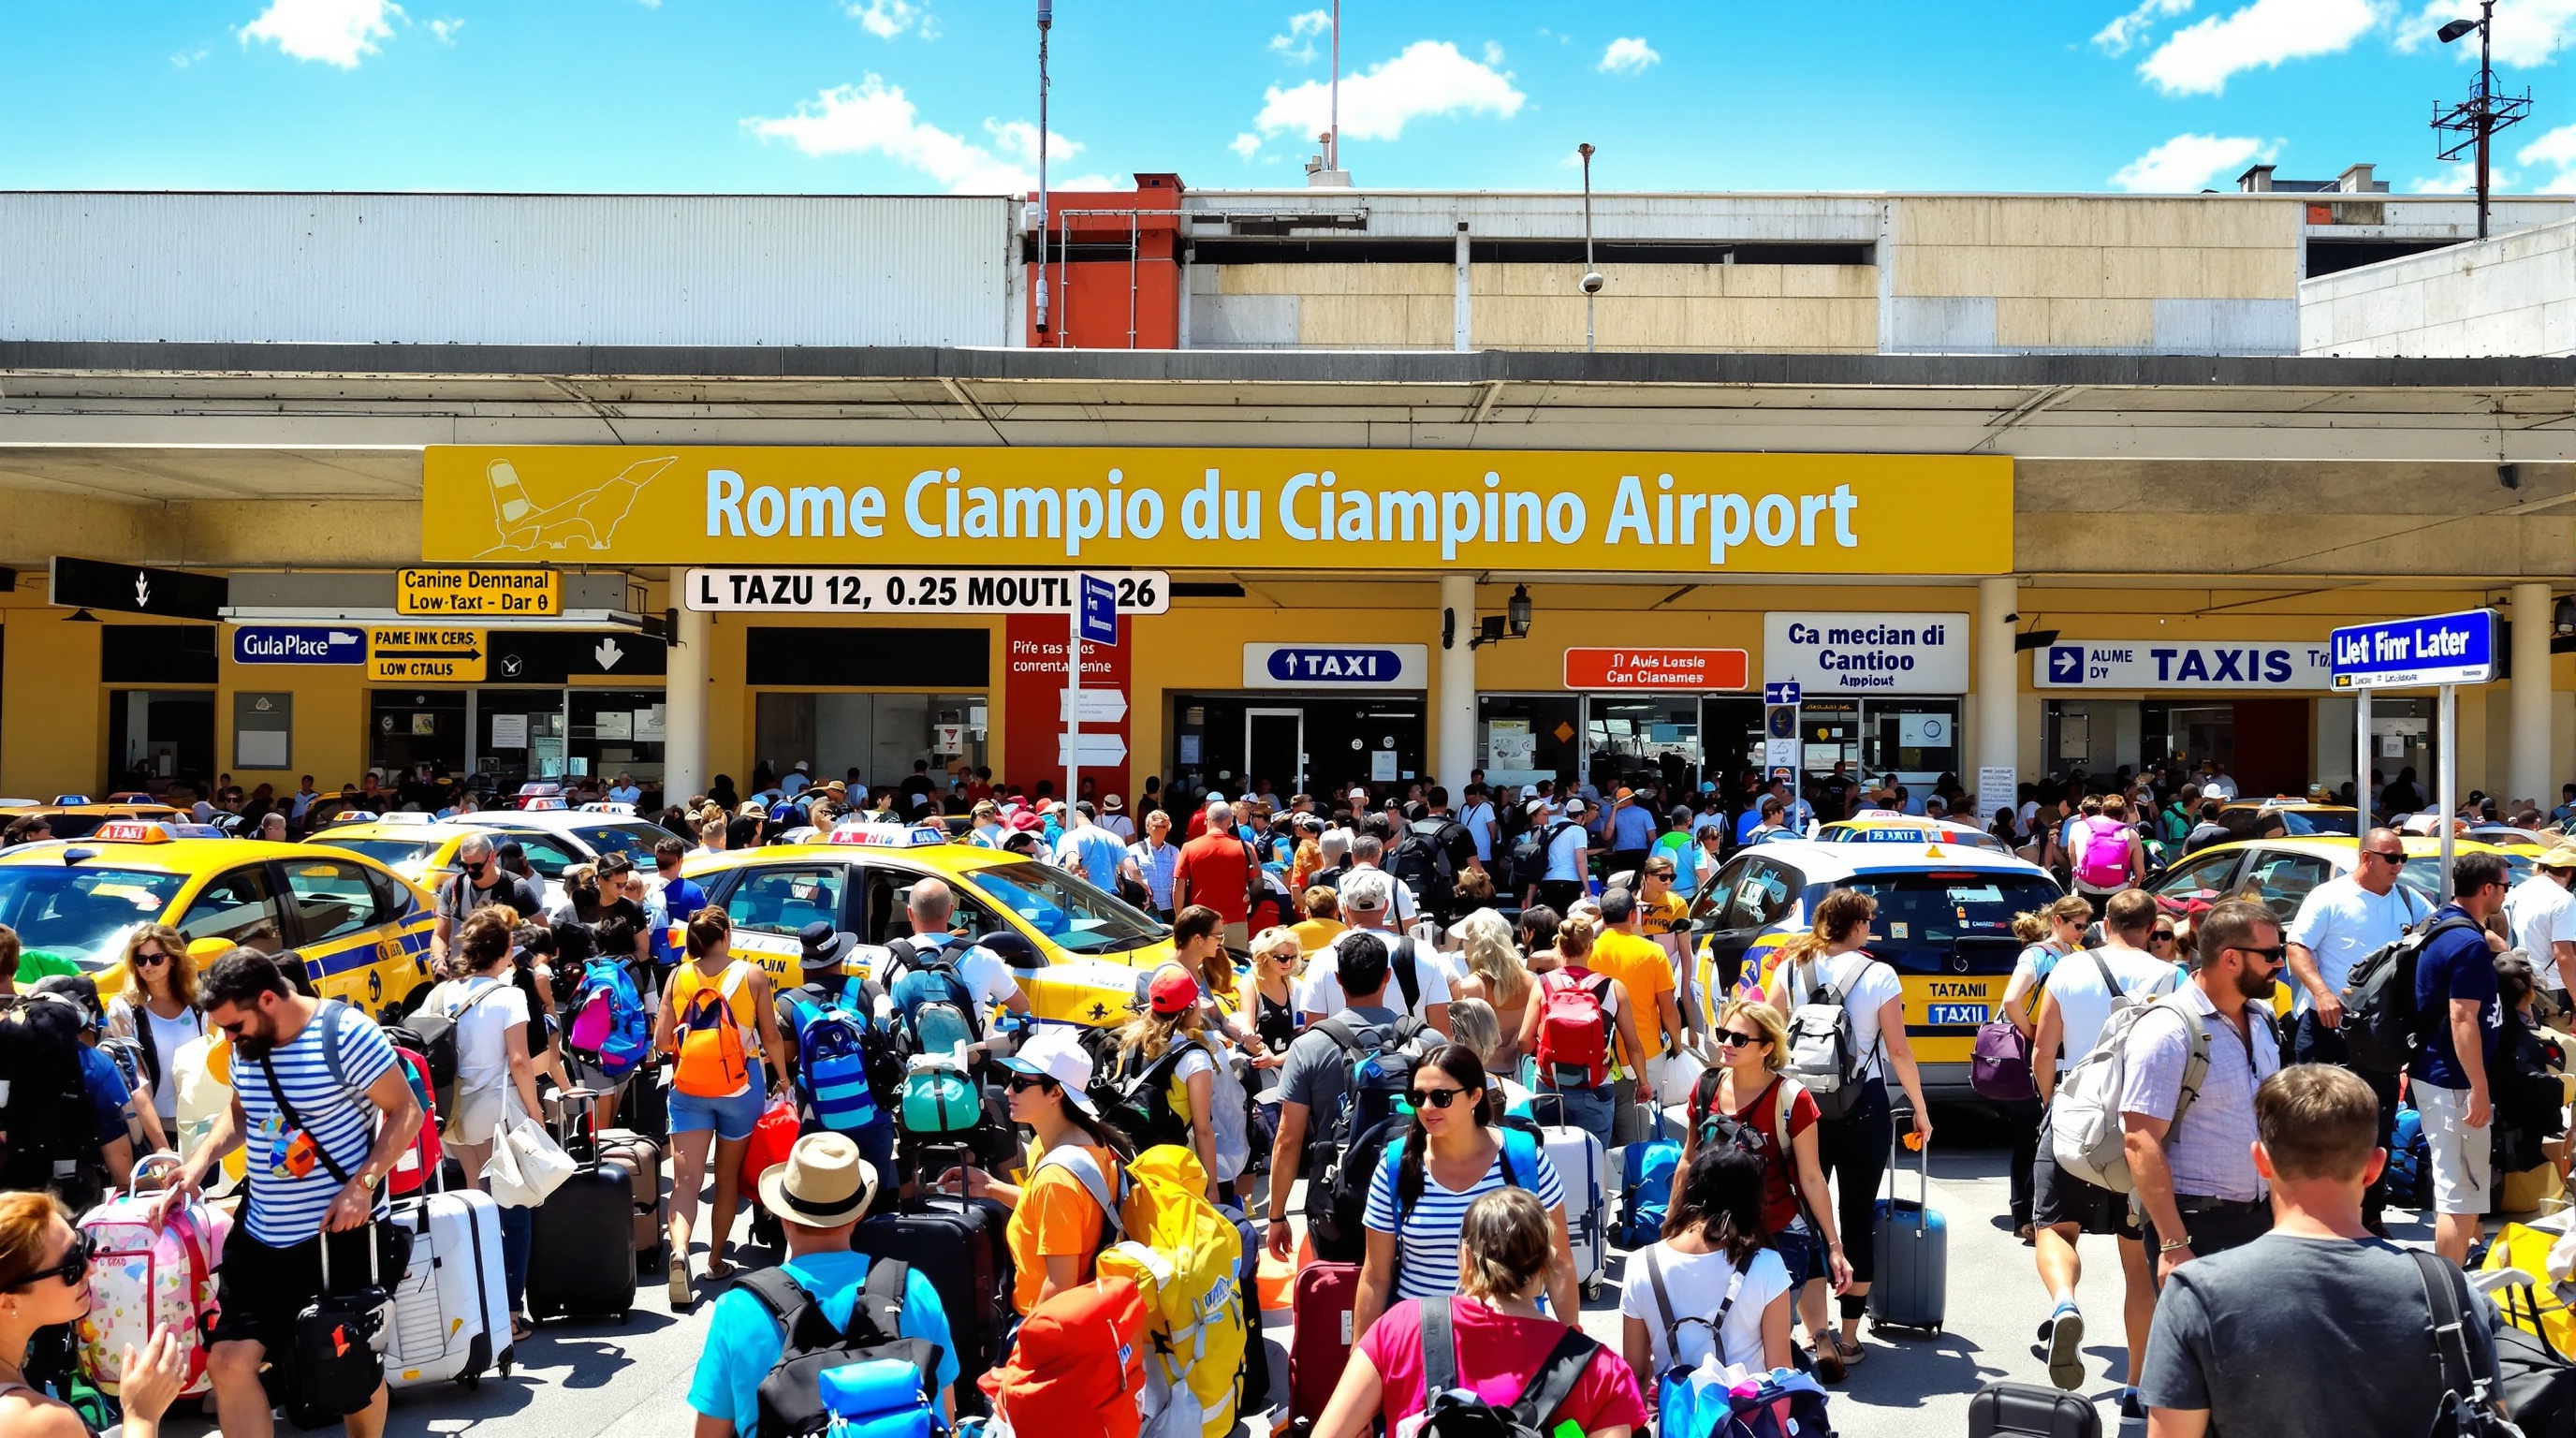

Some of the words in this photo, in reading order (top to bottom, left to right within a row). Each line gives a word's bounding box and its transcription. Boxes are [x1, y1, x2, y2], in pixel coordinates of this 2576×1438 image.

[708, 470, 887, 540] Rome
[905, 468, 1165, 557] Ciampio
[1181, 469, 1262, 541] du
[1280, 471, 1588, 562] Ciampino
[1605, 474, 1859, 565] Airport
[405, 571, 461, 588] Canine
[502, 594, 532, 609] Dar
[701, 576, 719, 605] L
[730, 576, 812, 605] TAZU
[826, 577, 872, 610] 12,
[886, 577, 957, 607] 0.25
[415, 632, 437, 645] INK
[1789, 623, 1820, 644] Ca
[1829, 624, 1916, 645] mecian
[1922, 624, 1945, 645] di
[2415, 626, 2470, 658] Later
[380, 664, 406, 676] LOW
[1304, 655, 1377, 677] TAXI
[1606, 670, 1633, 683] Can
[2151, 649, 2292, 683] TAXIS
